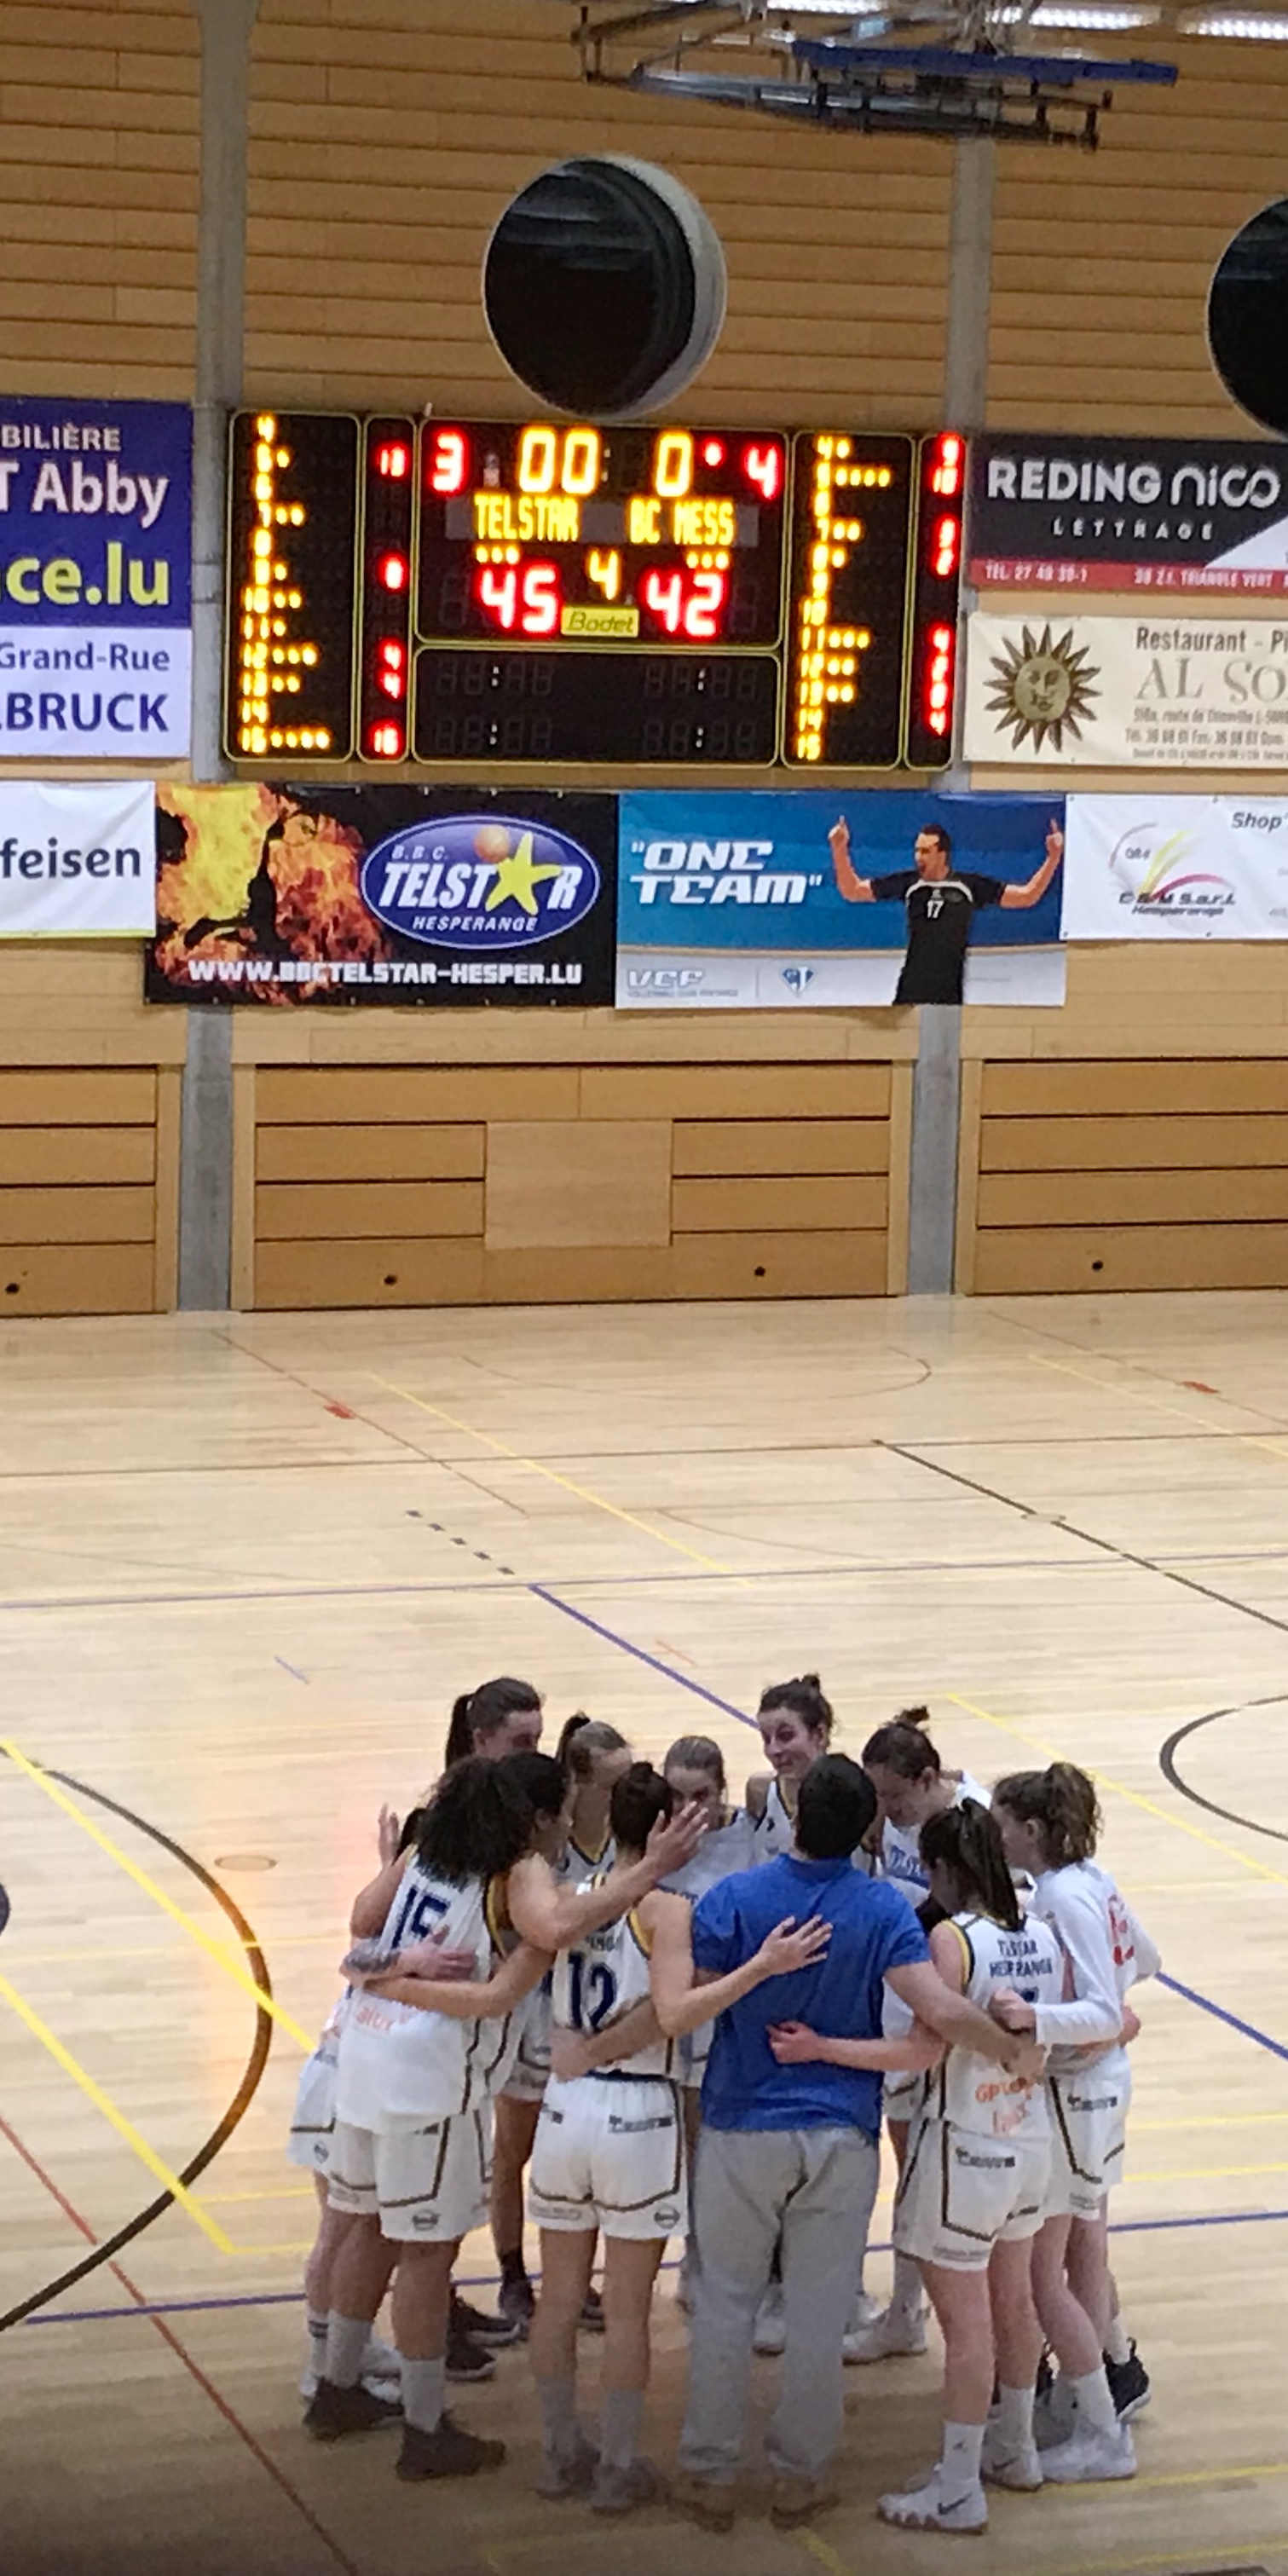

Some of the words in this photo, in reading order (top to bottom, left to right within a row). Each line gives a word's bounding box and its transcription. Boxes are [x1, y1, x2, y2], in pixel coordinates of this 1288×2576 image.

[1, 422, 122, 452] BILIÈRE
[432, 430, 465, 493] 3
[747, 446, 778, 496] 4
[988, 459, 1162, 505] REDING
[32, 458, 169, 528] Abby
[475, 494, 580, 542] TELSTAR
[630, 498, 661, 544] BC
[1053, 517, 1213, 541] LETTRAGE
[6, 540, 169, 606] ce.lu
[589, 549, 620, 601] 4
[1014, 561, 1032, 581] 27
[480, 567, 558, 633] 45
[567, 609, 633, 634] Bodet
[646, 570, 724, 637] 42
[243, 615, 269, 639] 11
[802, 627, 825, 651] 11
[1135, 625, 1246, 654] Restaurant
[0, 641, 170, 671] Grand-Rue
[1135, 657, 1204, 701] AL
[1222, 659, 1288, 706] SO
[0, 691, 169, 733] BRUCK
[0, 836, 141, 880] feisen
[412, 915, 538, 932] HESPERANGE
[927, 899, 944, 919] 17
